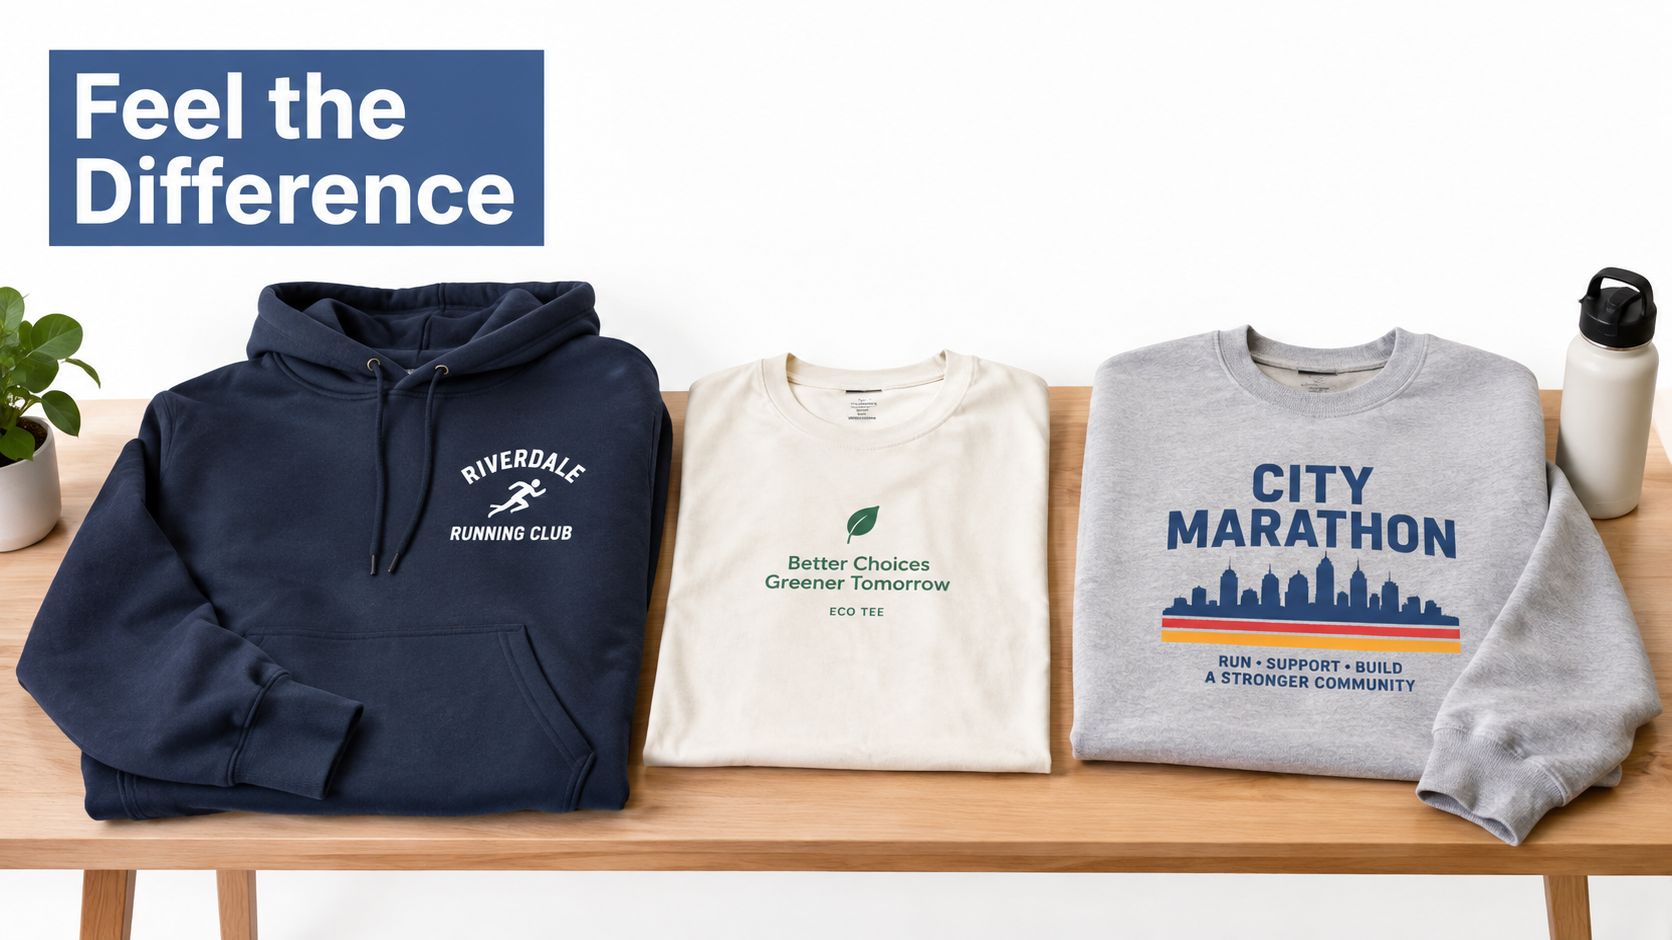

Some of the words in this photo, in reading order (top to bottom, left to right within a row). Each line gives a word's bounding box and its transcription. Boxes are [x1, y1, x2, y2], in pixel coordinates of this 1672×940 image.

[460, 448, 586, 485] RIVERDALE
[1252, 463, 1374, 505] CITY
[449, 526, 525, 541] RUNNING
[529, 526, 573, 541] CLUB
[1167, 508, 1457, 560] MARATHON
[788, 555, 849, 571] Better
[853, 555, 930, 572] Choices
[765, 574, 846, 591] Greener
[850, 575, 951, 592] Tomorrow
[829, 606, 856, 617] ECO
[860, 607, 884, 617] TEE
[1218, 655, 1252, 669] RUN
[1266, 658, 1341, 673] SUPPORT
[1355, 661, 1403, 675] BUILD
[1204, 671, 1216, 683] A
[1221, 671, 1309, 689] STRONGER
[1314, 675, 1416, 692] COMMUNITY
